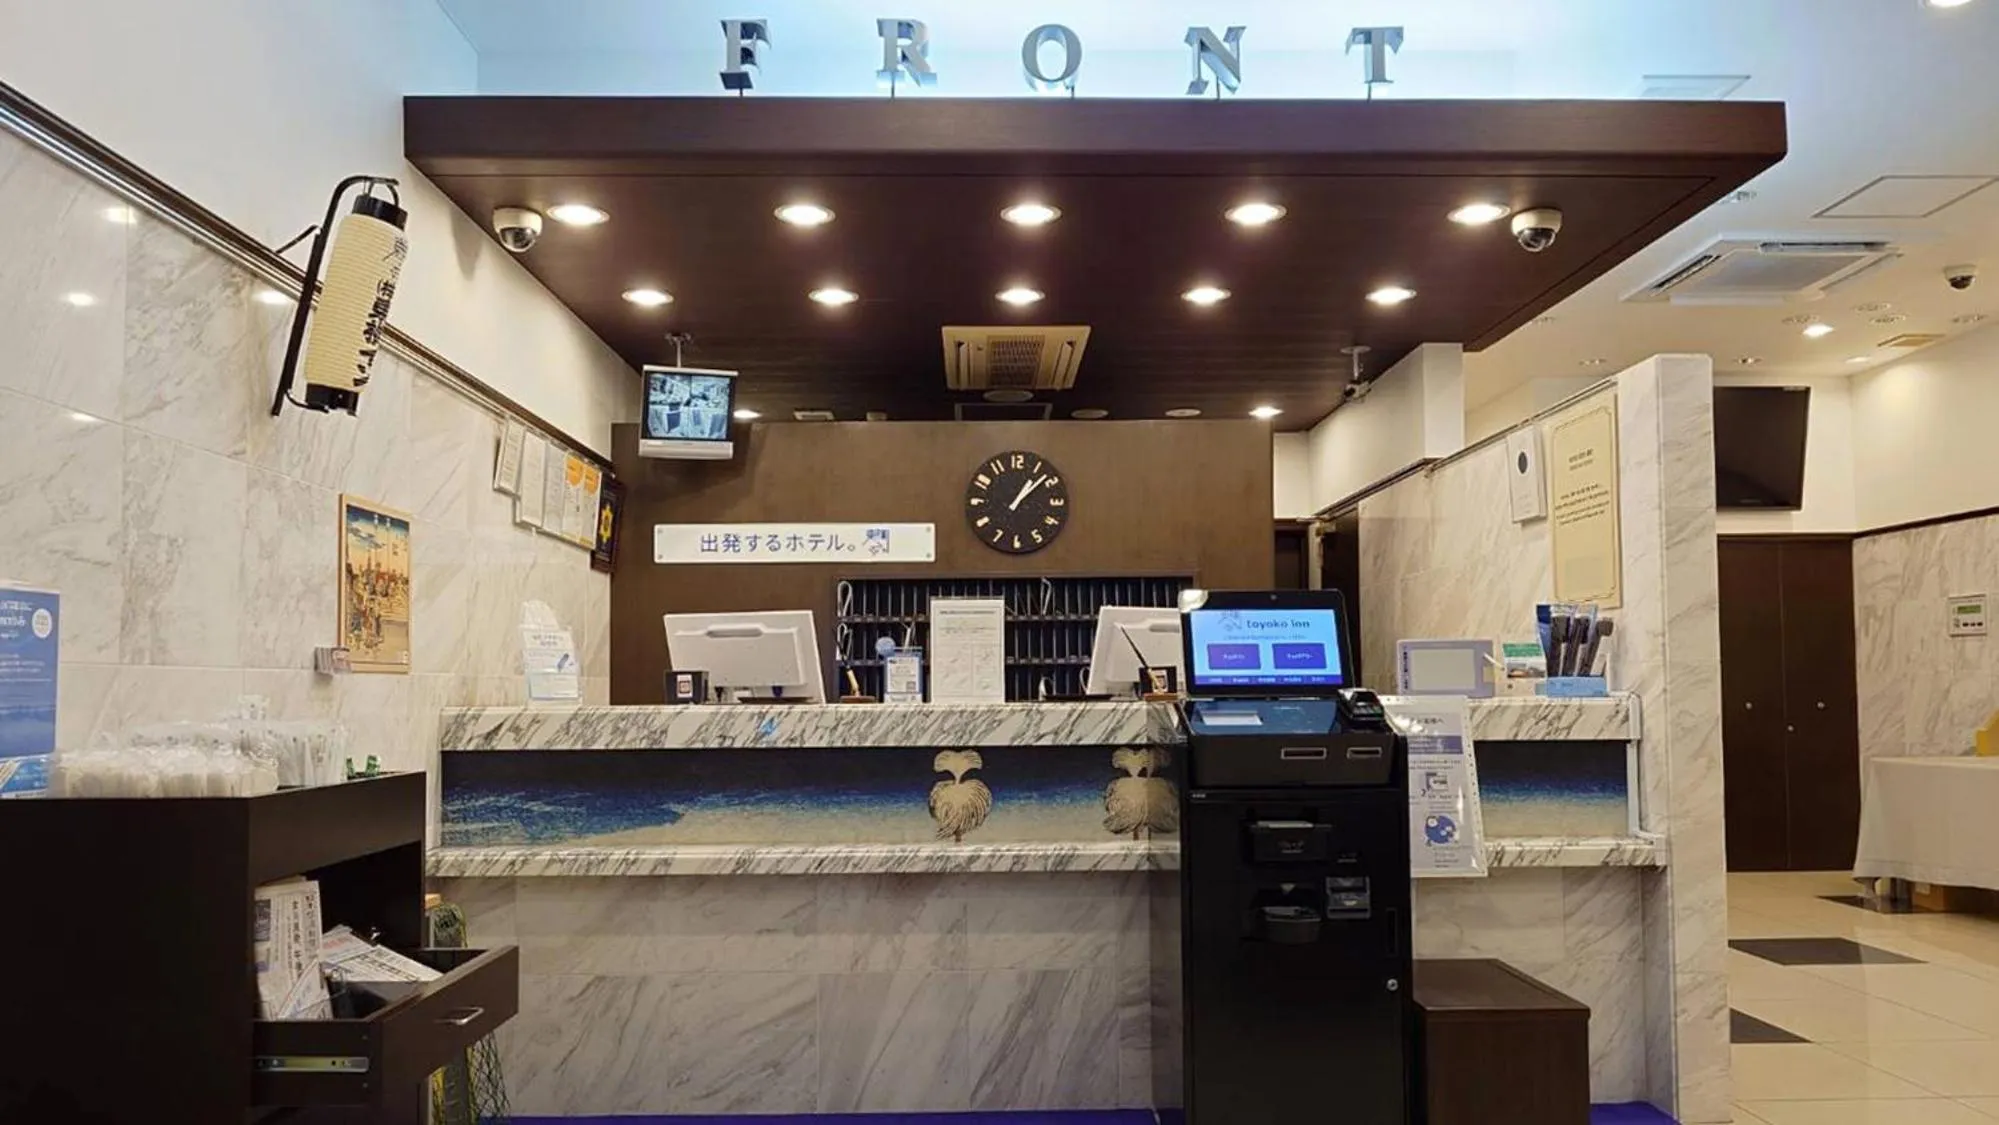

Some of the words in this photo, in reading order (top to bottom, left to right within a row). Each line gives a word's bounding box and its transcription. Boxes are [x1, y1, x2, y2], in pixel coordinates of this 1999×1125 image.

[719, 18, 1404, 95] FRONT
[1011, 455, 1023, 468] 12
[1033, 461, 1041, 473] 1
[1044, 476, 1058, 487] 2
[1049, 498, 1064, 506] 3
[1044, 515, 1058, 524] 4
[993, 528, 1003, 542] 7
[1013, 535, 1021, 548] 6
[1031, 528, 1042, 542] 5
[700, 533, 856, 553] 出発するホテル。
[1246, 619, 1289, 631] toyoko
